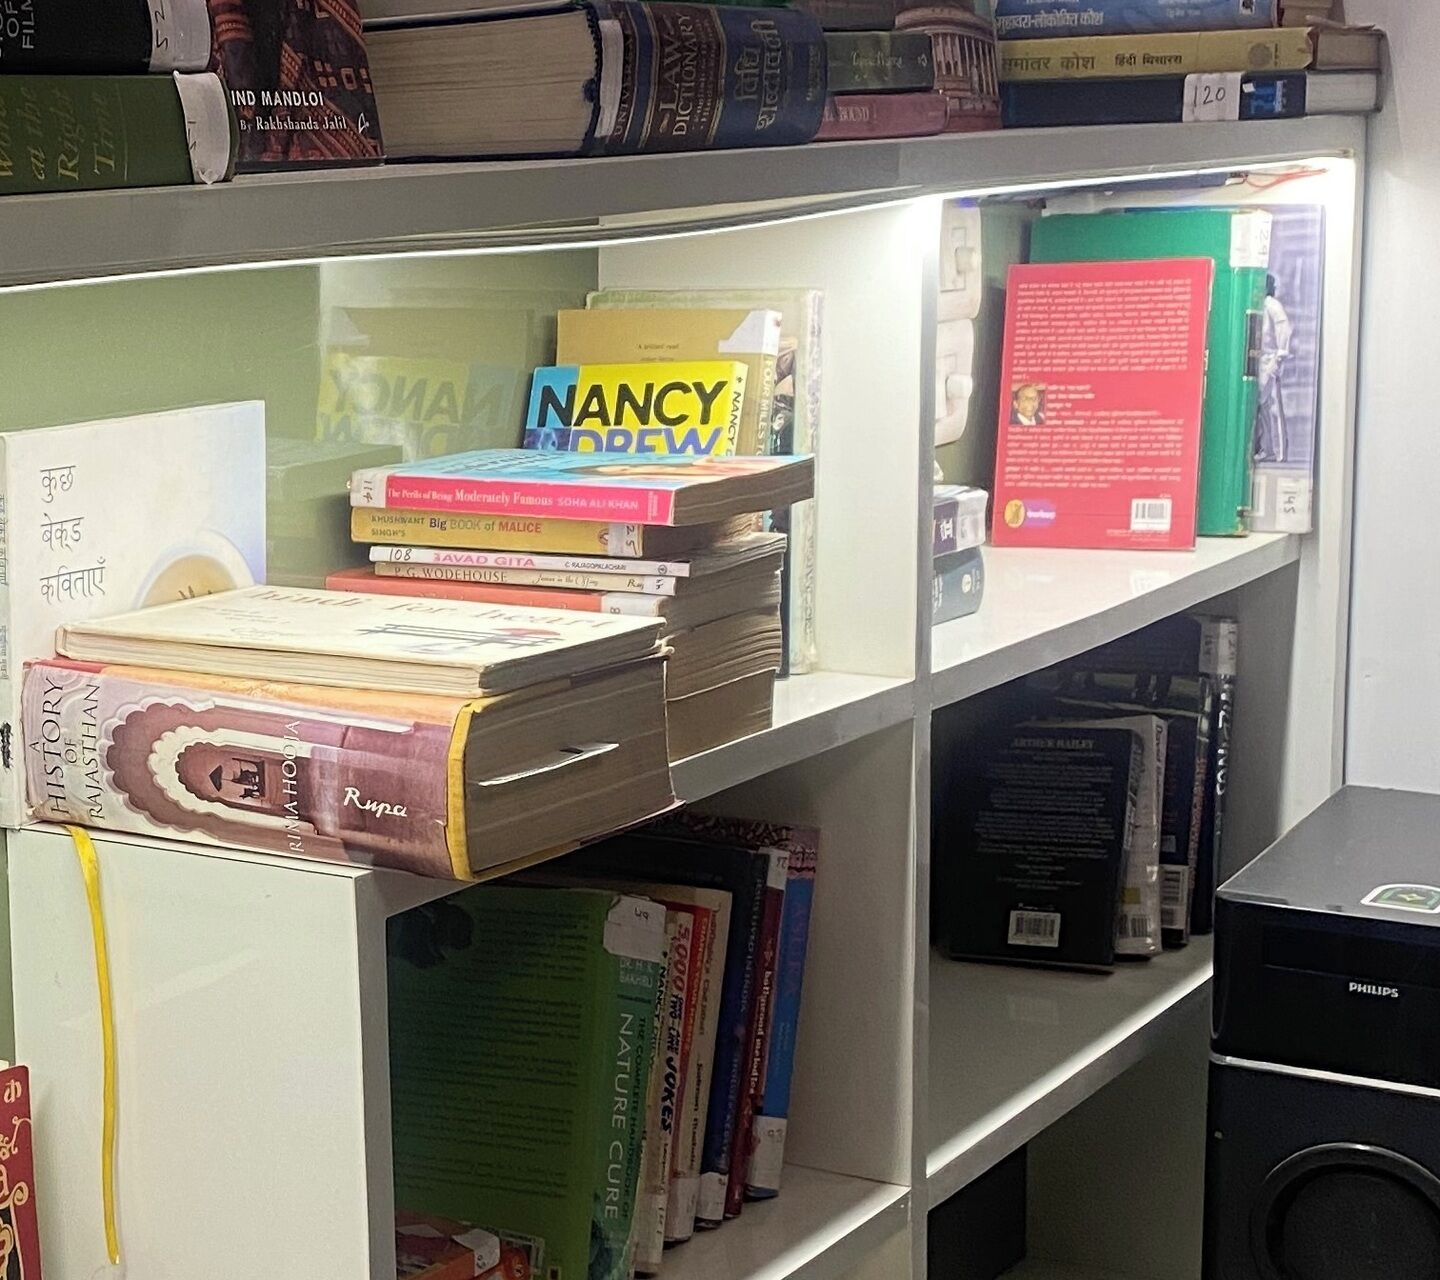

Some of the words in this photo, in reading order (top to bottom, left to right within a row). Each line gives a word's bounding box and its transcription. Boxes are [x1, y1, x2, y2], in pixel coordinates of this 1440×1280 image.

[6, 1, 20, 38] OF
[673, 15, 698, 136] DICTIONARY
[1060, 51, 1095, 70] कोश
[262, 90, 324, 107] MANDLOI
[1193, 84, 1227, 114] 120
[50, 89, 86, 182] Right
[240, 119, 253, 133] By
[256, 116, 320, 131] Rakhshanda
[322, 115, 348, 130] Jalil
[762, 360, 773, 397] FOUR
[536, 380, 729, 428] NANCY
[724, 389, 742, 450] NANCY
[759, 399, 772, 440] MILES
[569, 426, 725, 455] DREW
[40, 465, 76, 503] कुछ
[388, 488, 400, 499] The
[401, 489, 422, 501] Perils
[423, 491, 431, 502] of
[431, 490, 453, 504] Being
[455, 488, 512, 509] Moderately
[513, 490, 553, 507] Famous
[558, 497, 588, 508] SOHA
[589, 498, 607, 509] ALI
[608, 499, 640, 511] KHAN
[371, 514, 426, 527] KHUSHWANT
[429, 516, 448, 531] Big
[450, 517, 482, 531] BOOK
[484, 519, 496, 532] of
[498, 521, 542, 534] MALICE
[371, 527, 406, 538] SINGH'S
[388, 547, 413, 562] 108
[494, 554, 535, 567] GITA
[40, 556, 106, 604] कविताएँ
[407, 566, 420, 578] G.
[421, 566, 509, 583] WODEHOUSE
[29, 741, 40, 752] A
[41, 677, 70, 815] HISTORY
[64, 737, 79, 765] OF
[81, 683, 106, 821] RAJASTHAN
[282, 720, 301, 795] HOOJA
[344, 786, 408, 818] Rupa
[289, 801, 305, 853] RIMA
[1349, 982, 1399, 998] PHILIPS
[611, 1012, 634, 1130] NATURE
[661, 1056, 677, 1136] JOKES
[604, 1140, 624, 1220] CURE
